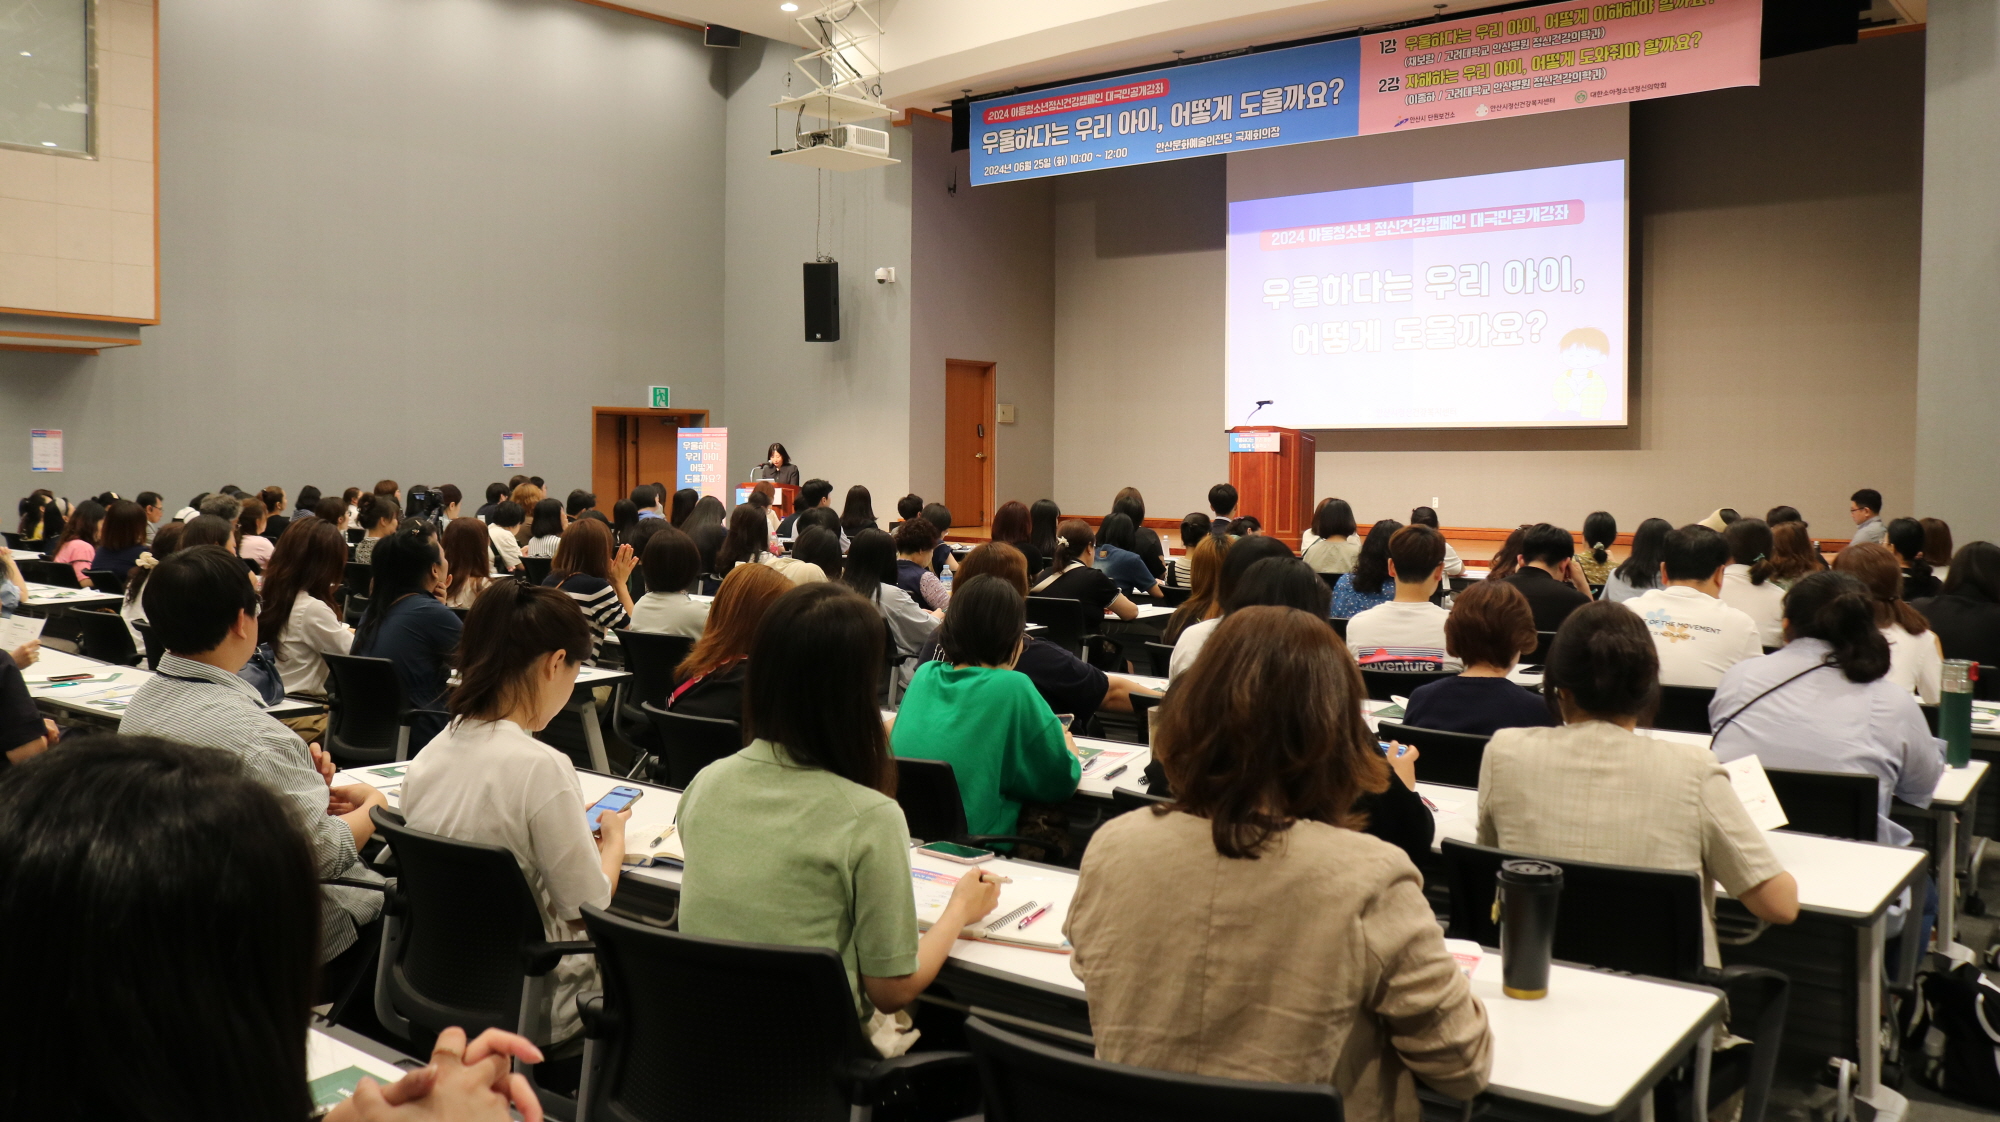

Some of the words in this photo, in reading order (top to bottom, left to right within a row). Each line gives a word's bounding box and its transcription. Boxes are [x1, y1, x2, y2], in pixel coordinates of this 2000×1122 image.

[1379, 39, 1397, 54] 1강
[1405, 28, 1471, 51] 우울하다는
[1475, 22, 1503, 40] 우리
[1507, 17, 1540, 35] 아이,
[1545, 8, 1588, 30] 어떻게
[1593, 0, 1655, 22] 이해해야
[1444, 45, 1490, 62] 고려대학교
[1492, 38, 1530, 55] 안산병원
[1532, 26, 1606, 48] 정신건강의학과)
[1378, 76, 1400, 93] 2강
[1405, 69, 1459, 89] 자해하는
[1463, 63, 1490, 81] 우리
[1494, 58, 1527, 77] 아이,
[1531, 50, 1575, 71] 어떻게
[1579, 41, 1640, 65] 도와줘야
[1643, 31, 1702, 57] 할까요?
[988, 109, 1009, 121] 2024
[1011, 93, 1103, 117] 아동청소년정신건강캠페인
[1105, 82, 1164, 102] 대국민공개강좌
[1445, 84, 1491, 100] 고려대학교
[1493, 78, 1531, 93] 안산병원
[1533, 67, 1607, 89] 정신건강의학과)
[1590, 82, 1667, 98] 대한소아청소년정신의학회
[982, 122, 1069, 155] 우울하다는
[1075, 113, 1112, 141] 우리
[1118, 106, 1164, 134] 아이,
[1170, 94, 1233, 128] 어떻게
[1239, 77, 1345, 119] 도울까요?
[1409, 113, 1426, 124] 안산시
[1156, 132, 1233, 154] 안산문화예술의전당
[1235, 126, 1281, 142] 국제회의장
[984, 163, 1012, 177] 2024년
[1014, 160, 1032, 172] 06월
[1034, 157, 1051, 169] 25일
[1053, 155, 1068, 168] (화)
[1070, 152, 1093, 165] 10:00
[1105, 147, 1128, 160] 12:00
[1271, 231, 1305, 246] 2024
[1308, 223, 1371, 242] 아동청소년
[1374, 214, 1466, 237] 정신건강캠페인
[1470, 203, 1569, 228] 대국민공개강좌
[1262, 269, 1413, 310] 우울하다는
[1425, 261, 1490, 300] 우리
[1503, 255, 1585, 295] 아이,
[1292, 318, 1381, 355] 어떻게
[1393, 309, 1548, 351] 도울까요?
[685, 452, 701, 461] 우리
[1677, 622, 1721, 634] MOVEMENT
